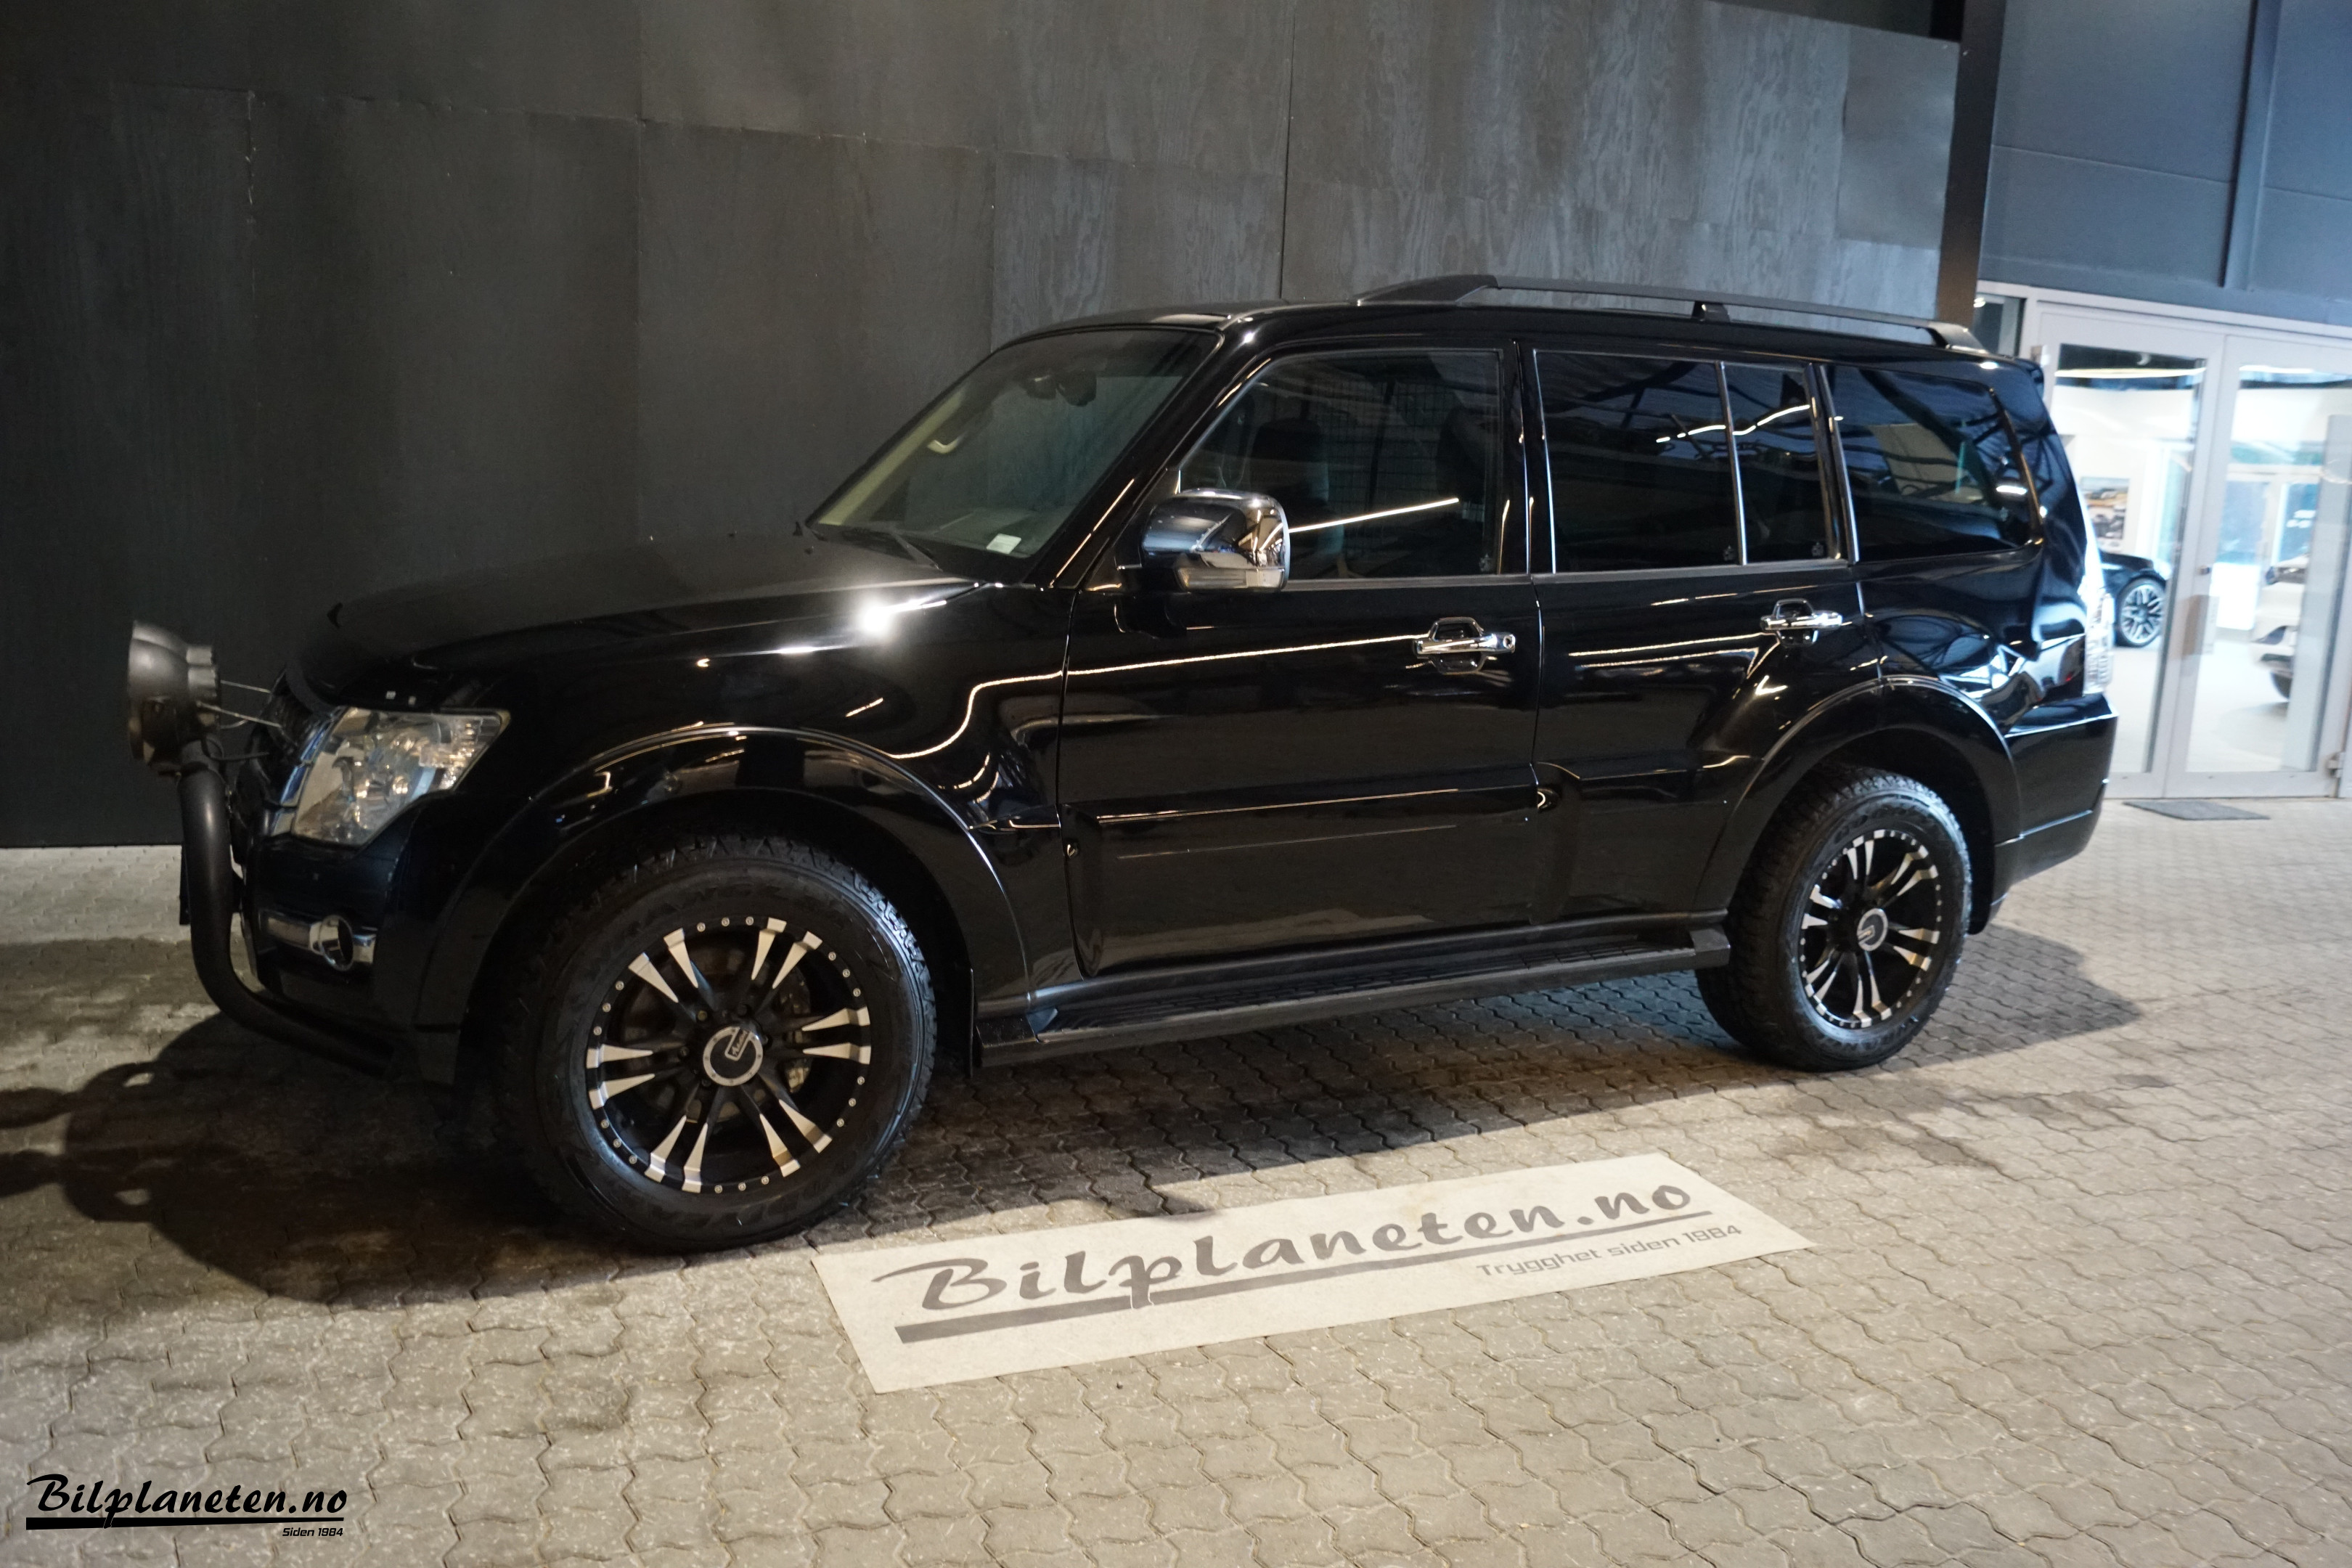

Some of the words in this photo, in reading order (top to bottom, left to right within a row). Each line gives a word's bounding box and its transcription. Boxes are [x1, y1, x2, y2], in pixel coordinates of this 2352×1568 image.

[872, 1184, 1691, 1310] Bilplaneten.no
[1476, 1248, 1601, 1276] Trygghet
[1606, 1236, 1681, 1257] siden
[1682, 1224, 1742, 1244] 1984
